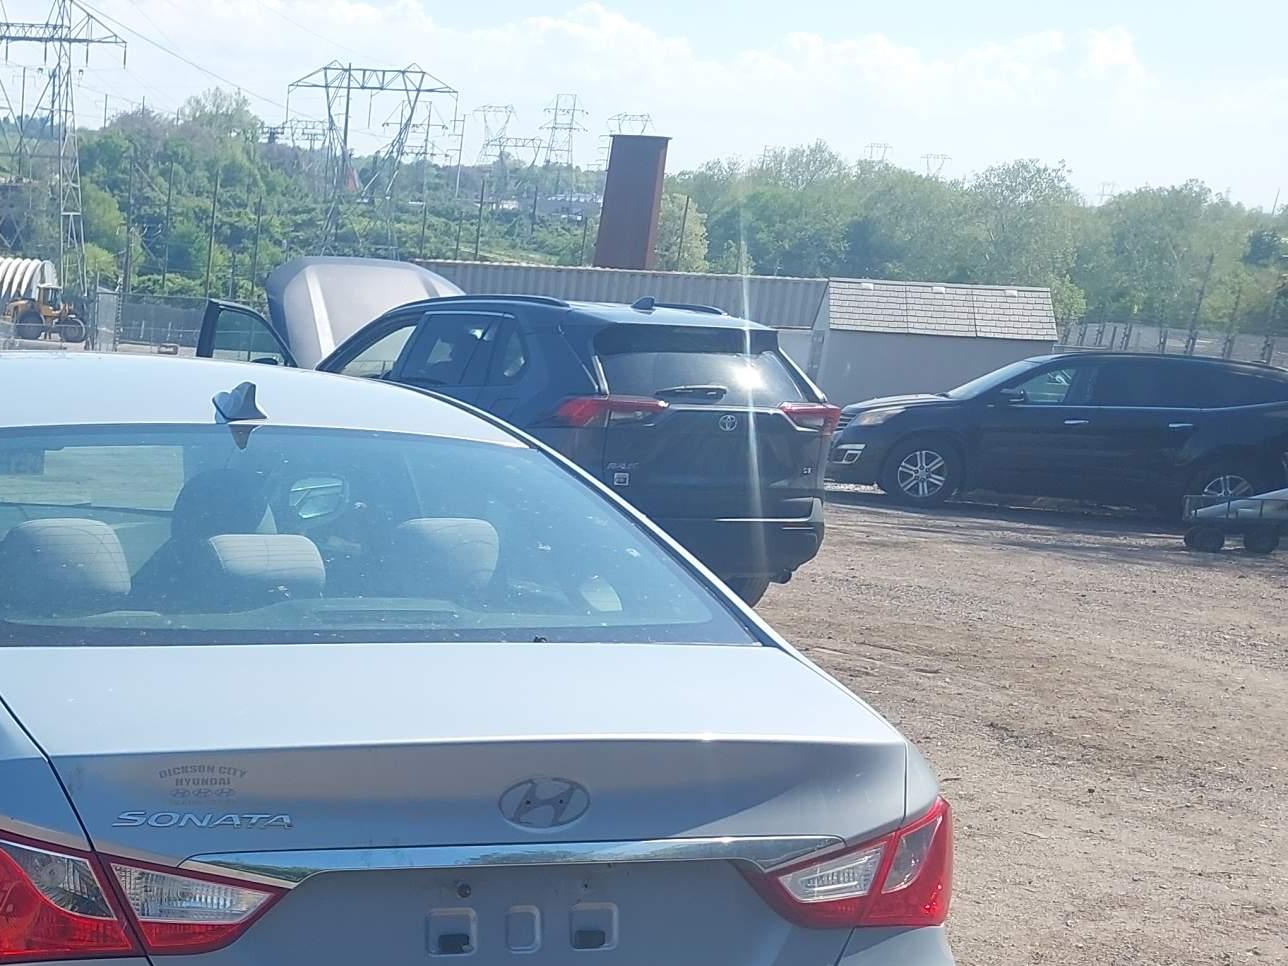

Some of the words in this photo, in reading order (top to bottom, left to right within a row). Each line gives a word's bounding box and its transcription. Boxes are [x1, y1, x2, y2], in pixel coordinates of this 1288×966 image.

[158, 764, 215, 779] DICKSON
[218, 766, 248, 779] CITY
[175, 777, 232, 787] HYUNDAI
[111, 811, 295, 829] SONATA
